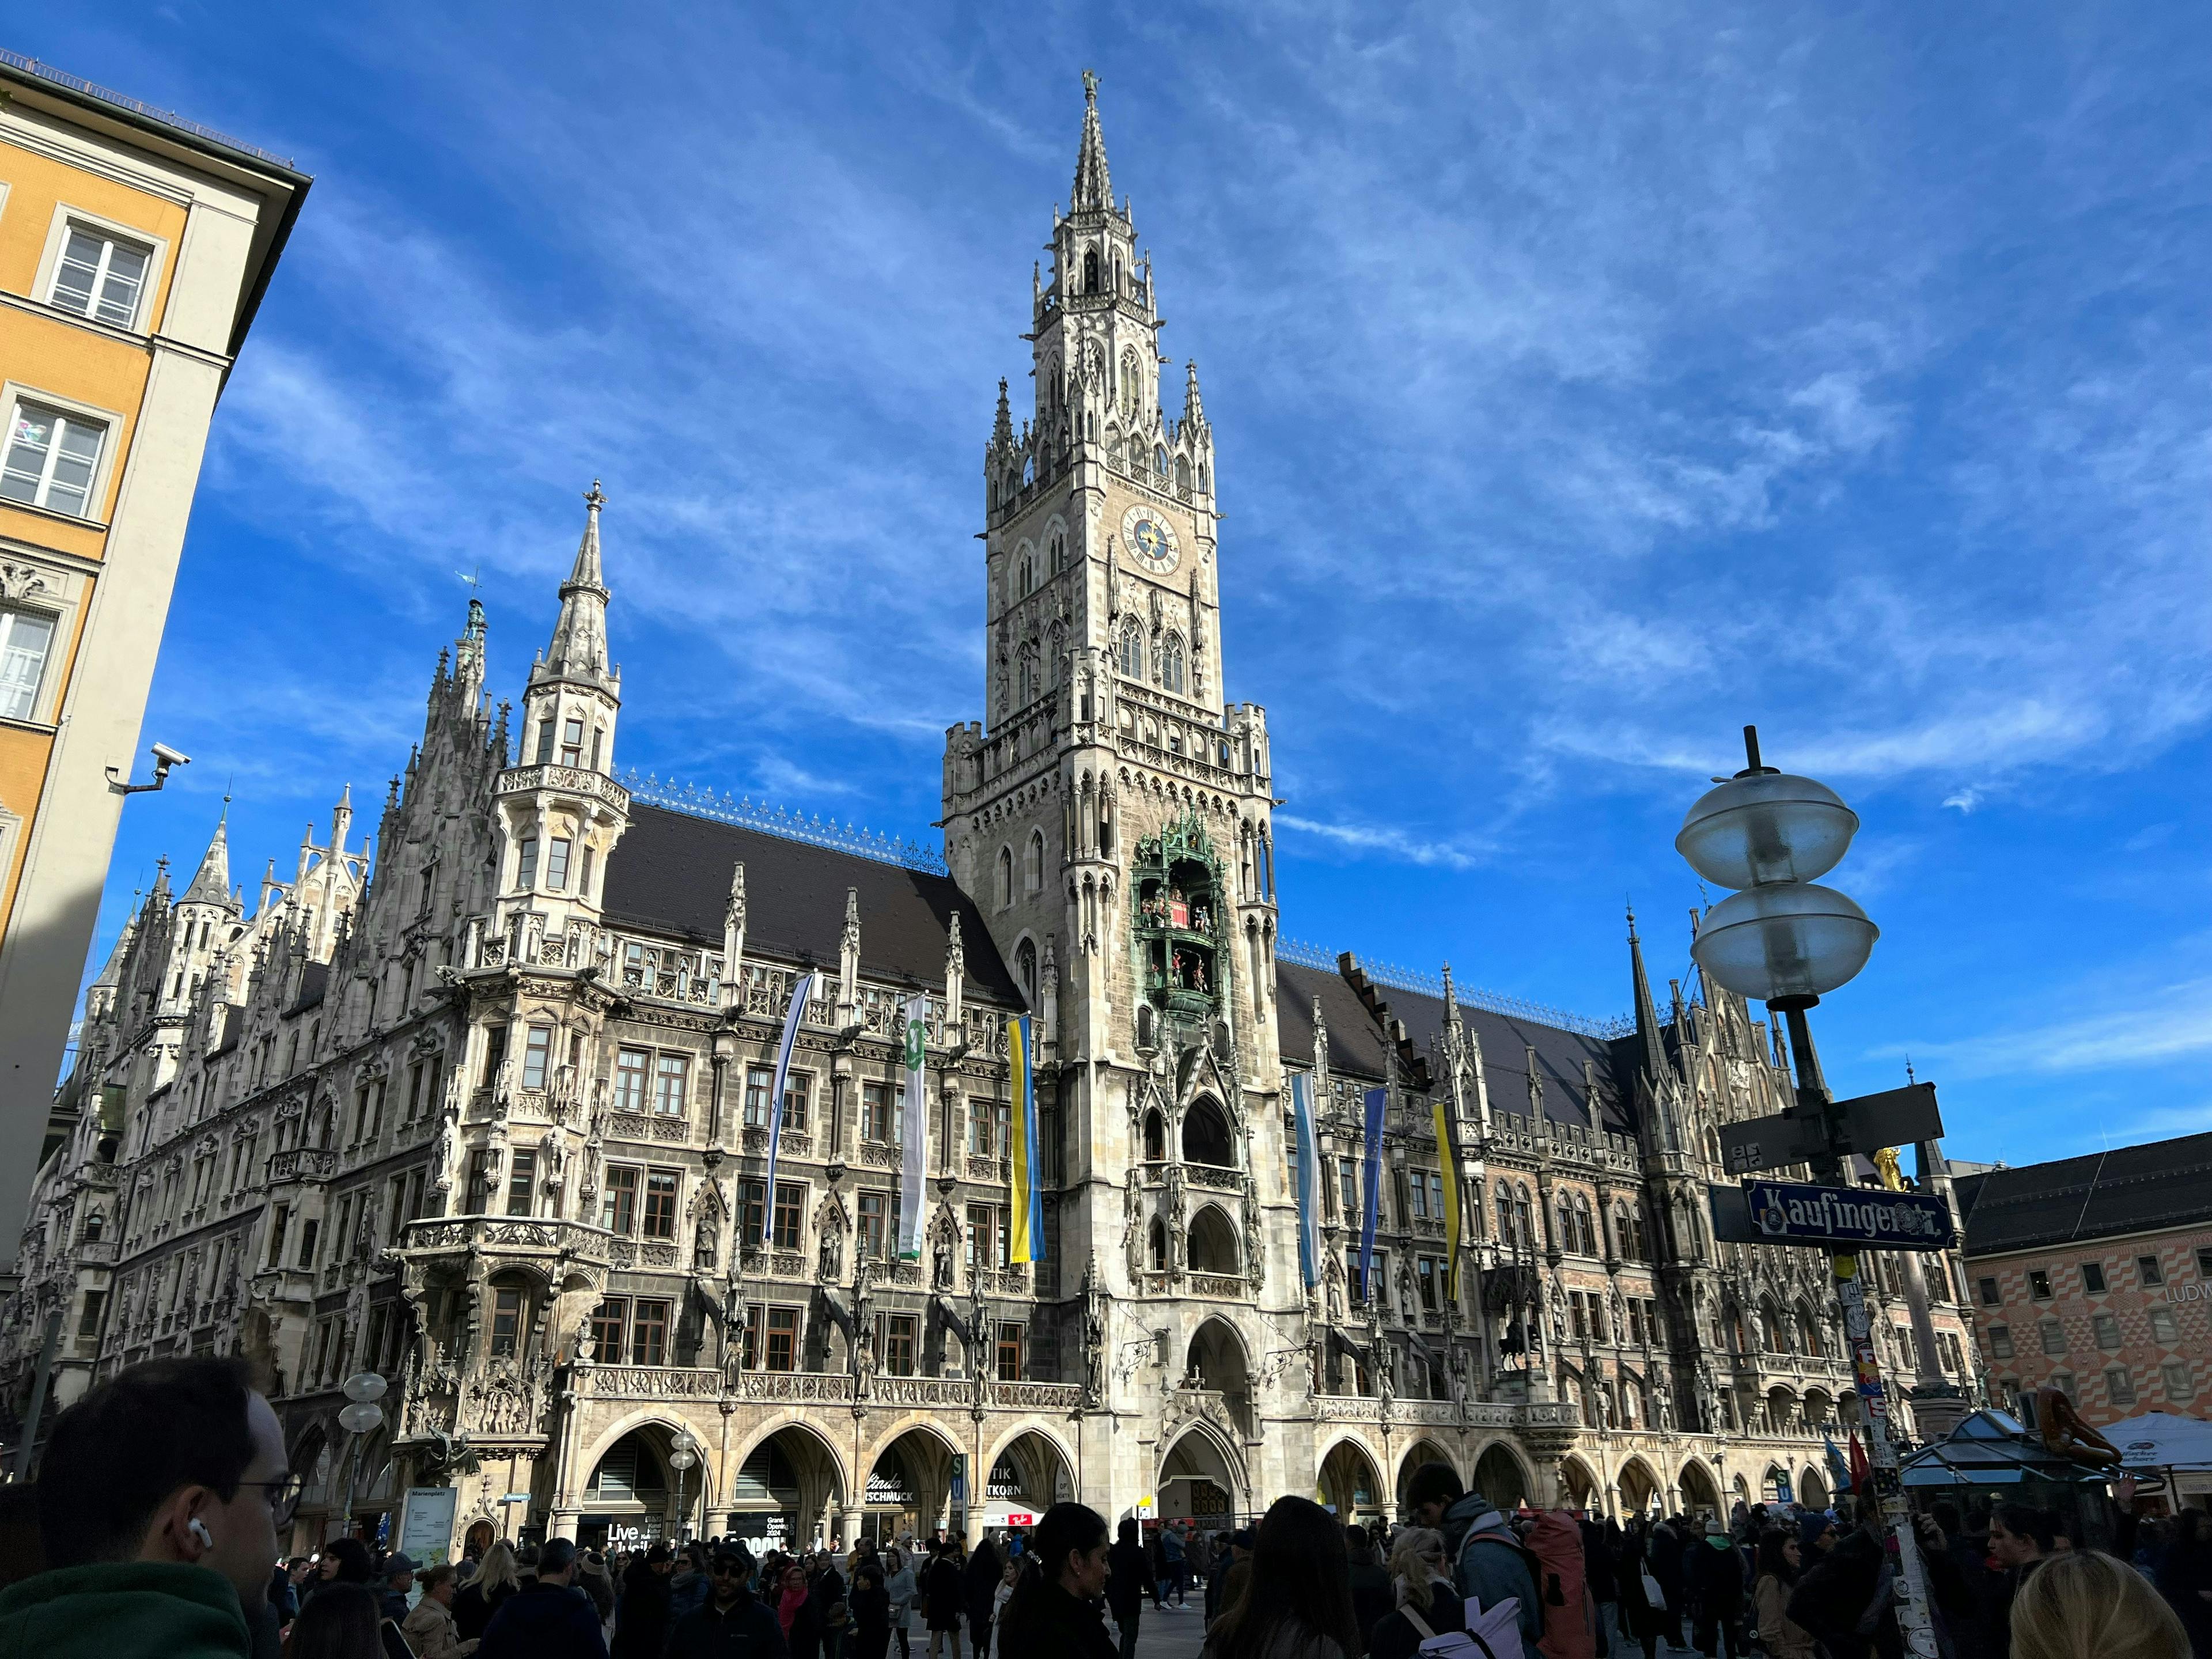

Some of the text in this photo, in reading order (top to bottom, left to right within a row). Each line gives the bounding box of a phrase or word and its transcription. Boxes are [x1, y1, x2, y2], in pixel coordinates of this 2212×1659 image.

[1763, 1188, 1942, 1239] Kaufingerr.
[953, 1457, 961, 1475] S
[1777, 1471, 1787, 1484] S
[953, 1479, 961, 1498] U
[1779, 1487, 1789, 1501] U
[608, 1523, 639, 1541] Live
